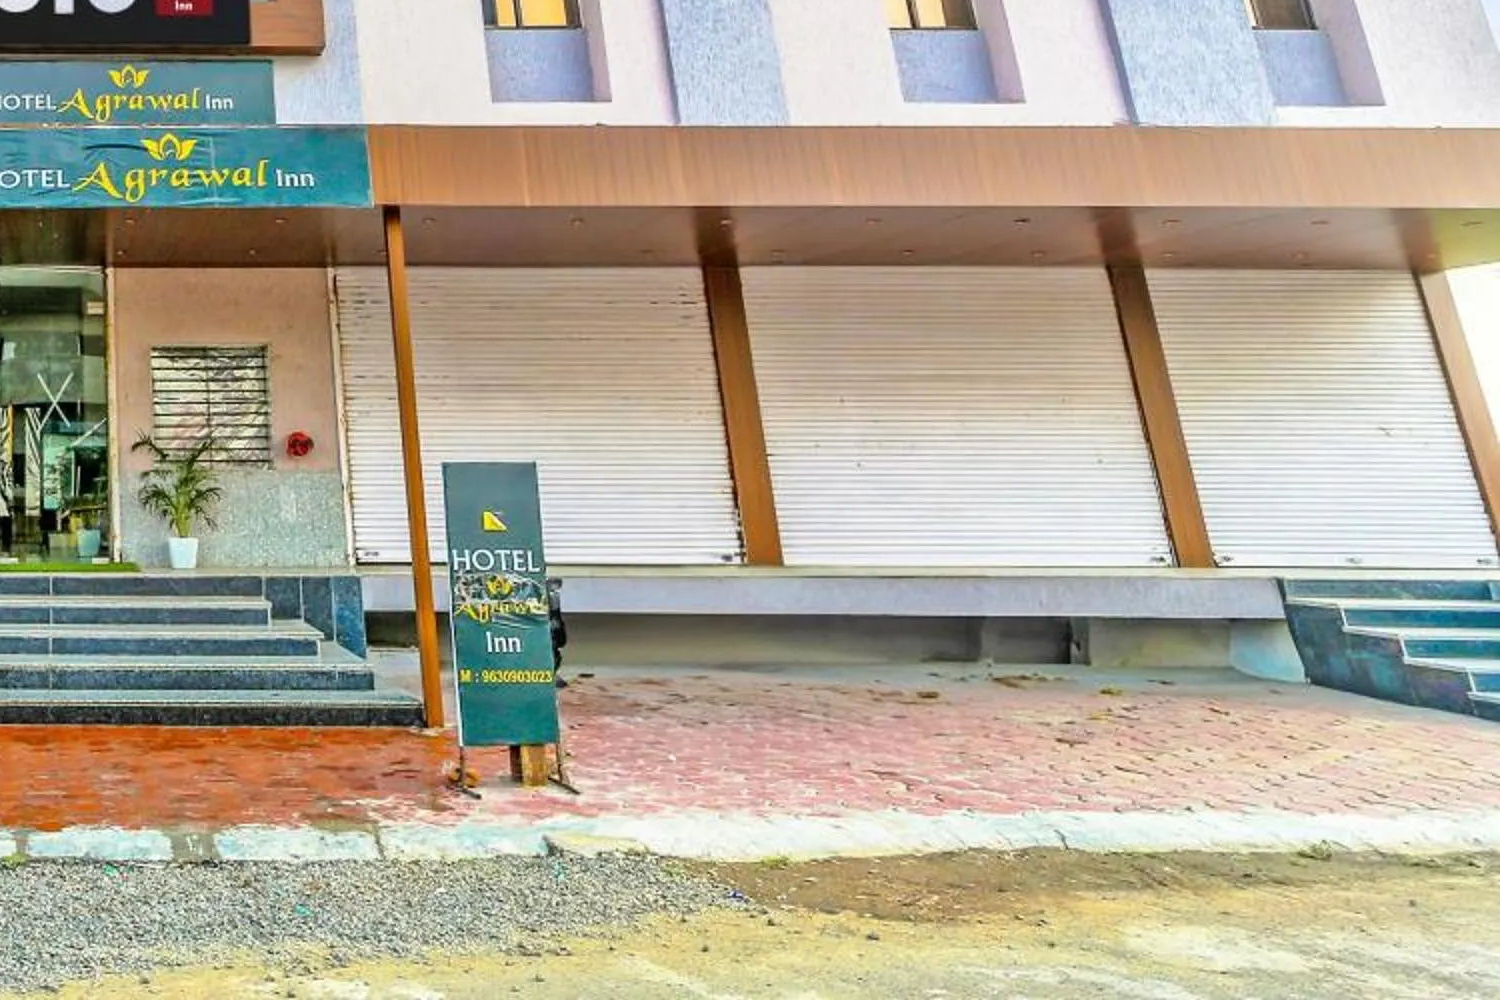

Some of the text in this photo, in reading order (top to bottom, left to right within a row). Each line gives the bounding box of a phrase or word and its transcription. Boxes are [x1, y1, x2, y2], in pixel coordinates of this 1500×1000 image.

[175, 0, 193, 11] Inn
[56, 87, 201, 122] Agrawal
[204, 93, 234, 110] Inn
[71, 159, 269, 203] Agrawal
[275, 168, 316, 188] Inn
[451, 548, 541, 573] HOTEL
[485, 631, 522, 654] Inn
